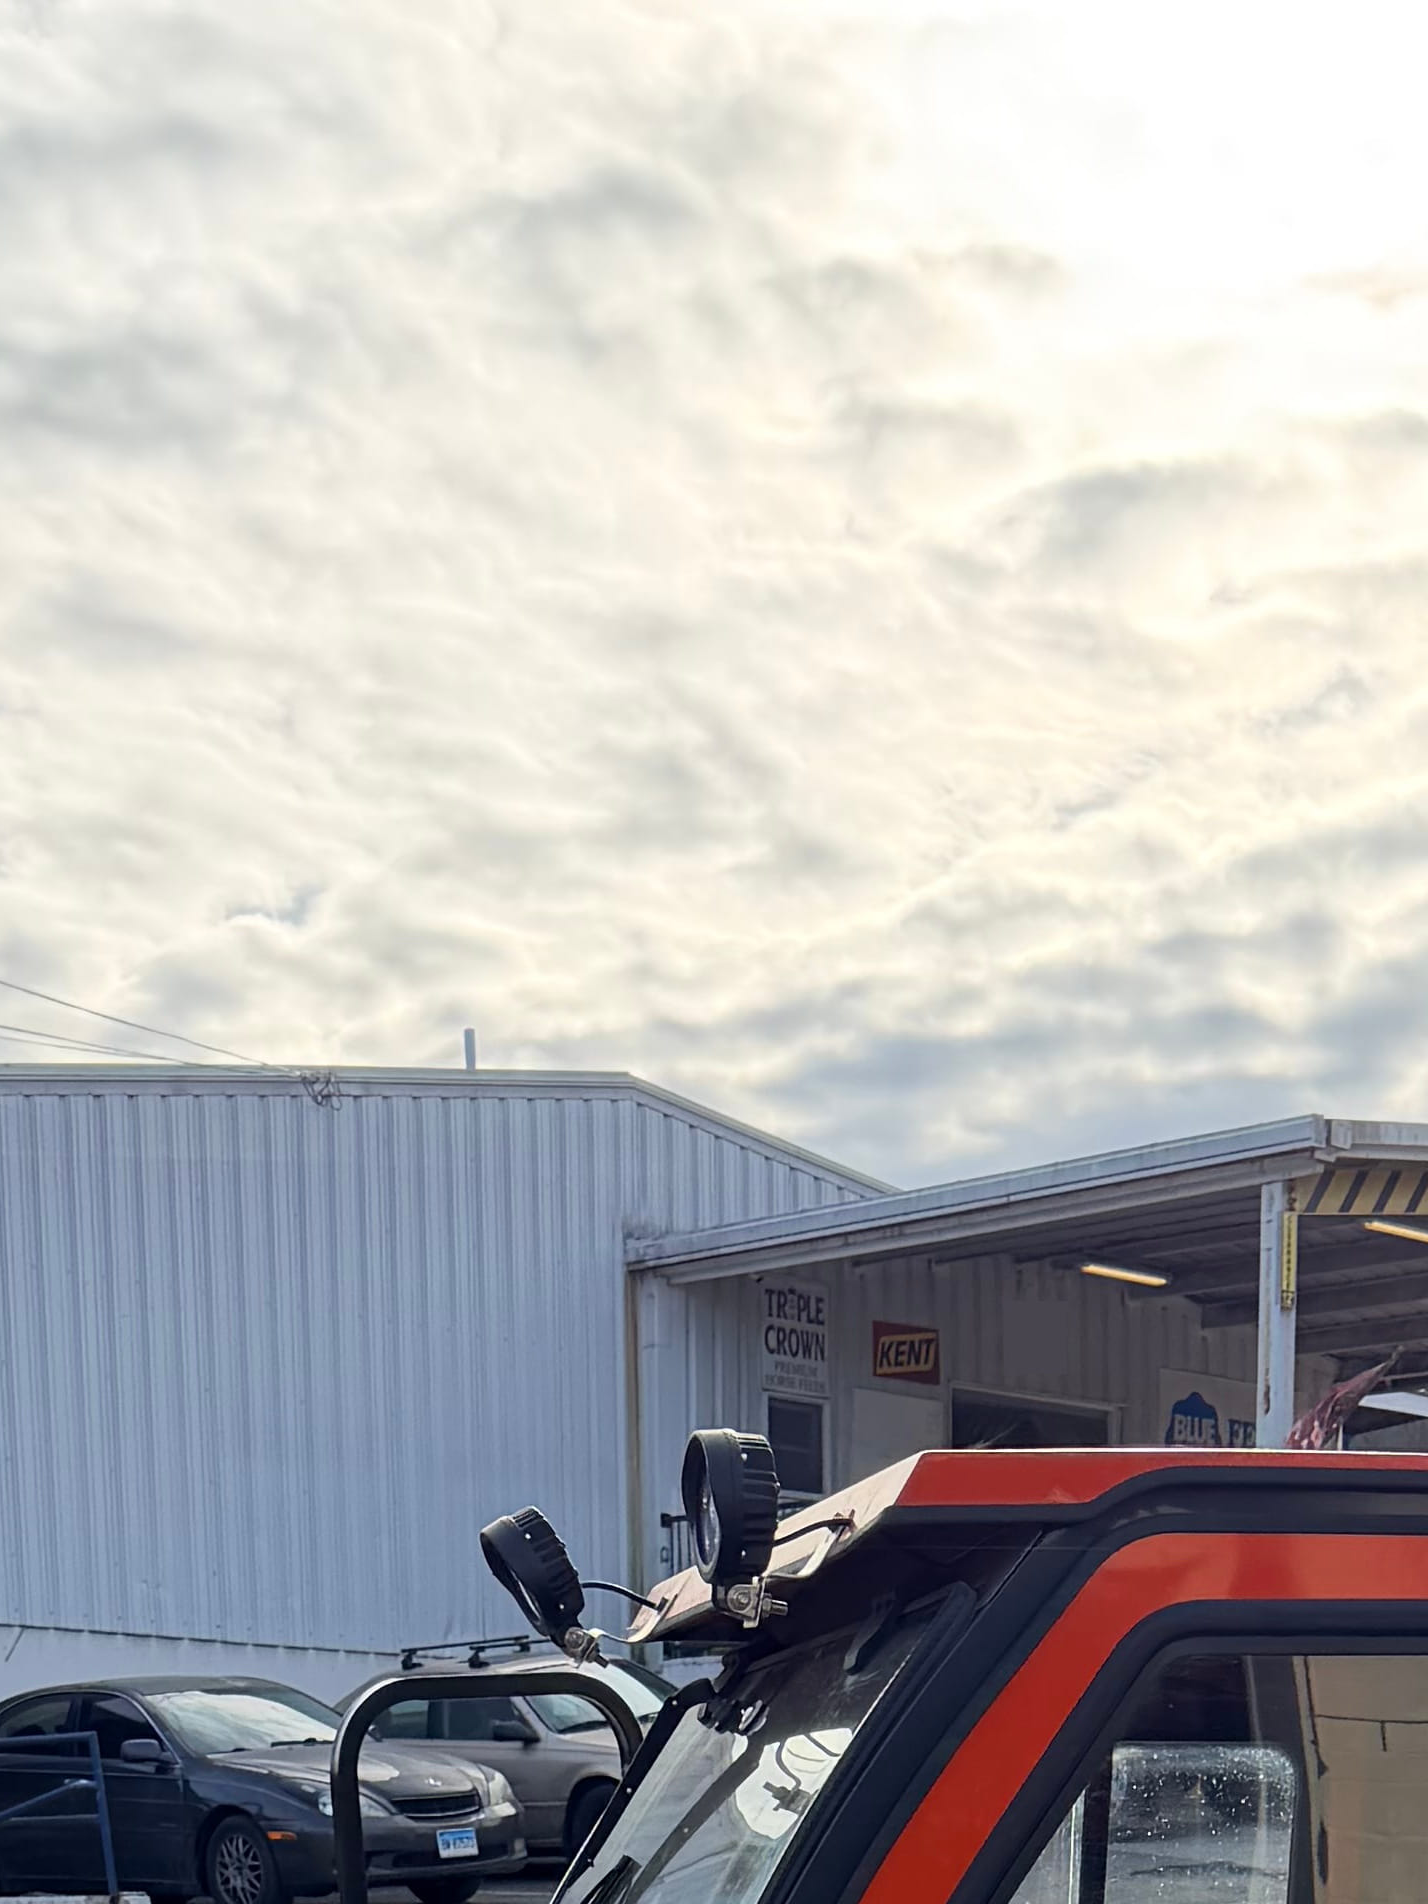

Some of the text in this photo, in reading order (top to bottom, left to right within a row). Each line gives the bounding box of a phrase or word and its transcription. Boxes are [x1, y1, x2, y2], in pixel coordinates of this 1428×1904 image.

[764, 1286, 825, 1326] TRIPLE
[764, 1324, 825, 1362] CROWN
[878, 1338, 935, 1369] KENT
[1173, 1413, 1216, 1444] BLUE
